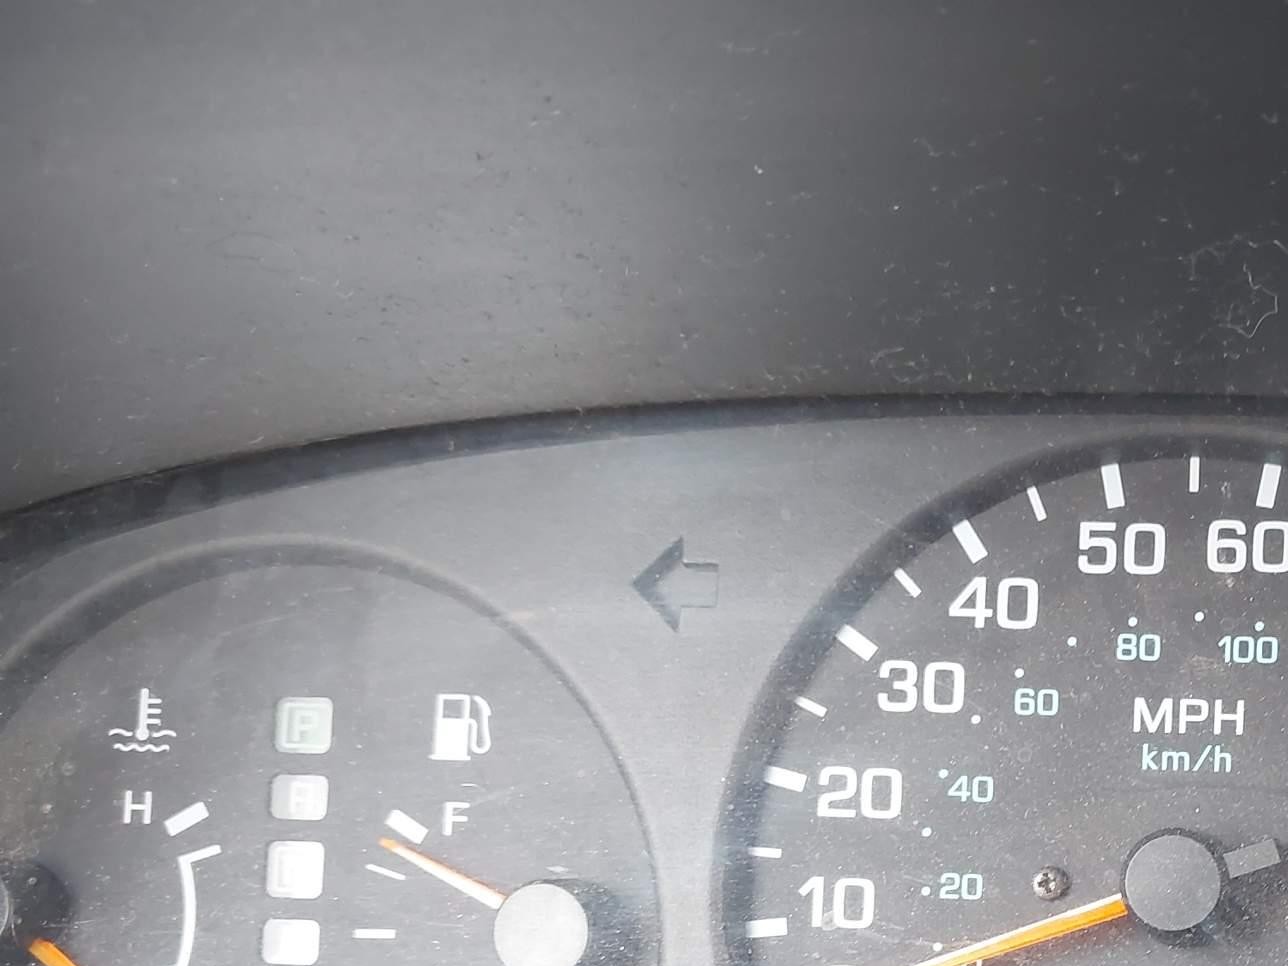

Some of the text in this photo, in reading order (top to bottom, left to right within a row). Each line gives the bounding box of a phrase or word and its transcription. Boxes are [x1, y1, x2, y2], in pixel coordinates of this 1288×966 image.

[1078, 521, 1166, 575] 50
[948, 576, 1039, 630] 40
[1116, 633, 1161, 661] 80
[1218, 635, 1278, 664] 100
[877, 659, 965, 714] 30
[1014, 687, 1059, 716] 60
[1132, 696, 1245, 735] MPH
[1141, 743, 1232, 773] km/h
[816, 765, 903, 820] 20
[947, 775, 994, 803] 40
[123, 790, 153, 825] H
[442, 801, 471, 836] F
[798, 876, 875, 930] 10
[939, 872, 983, 900] 20
